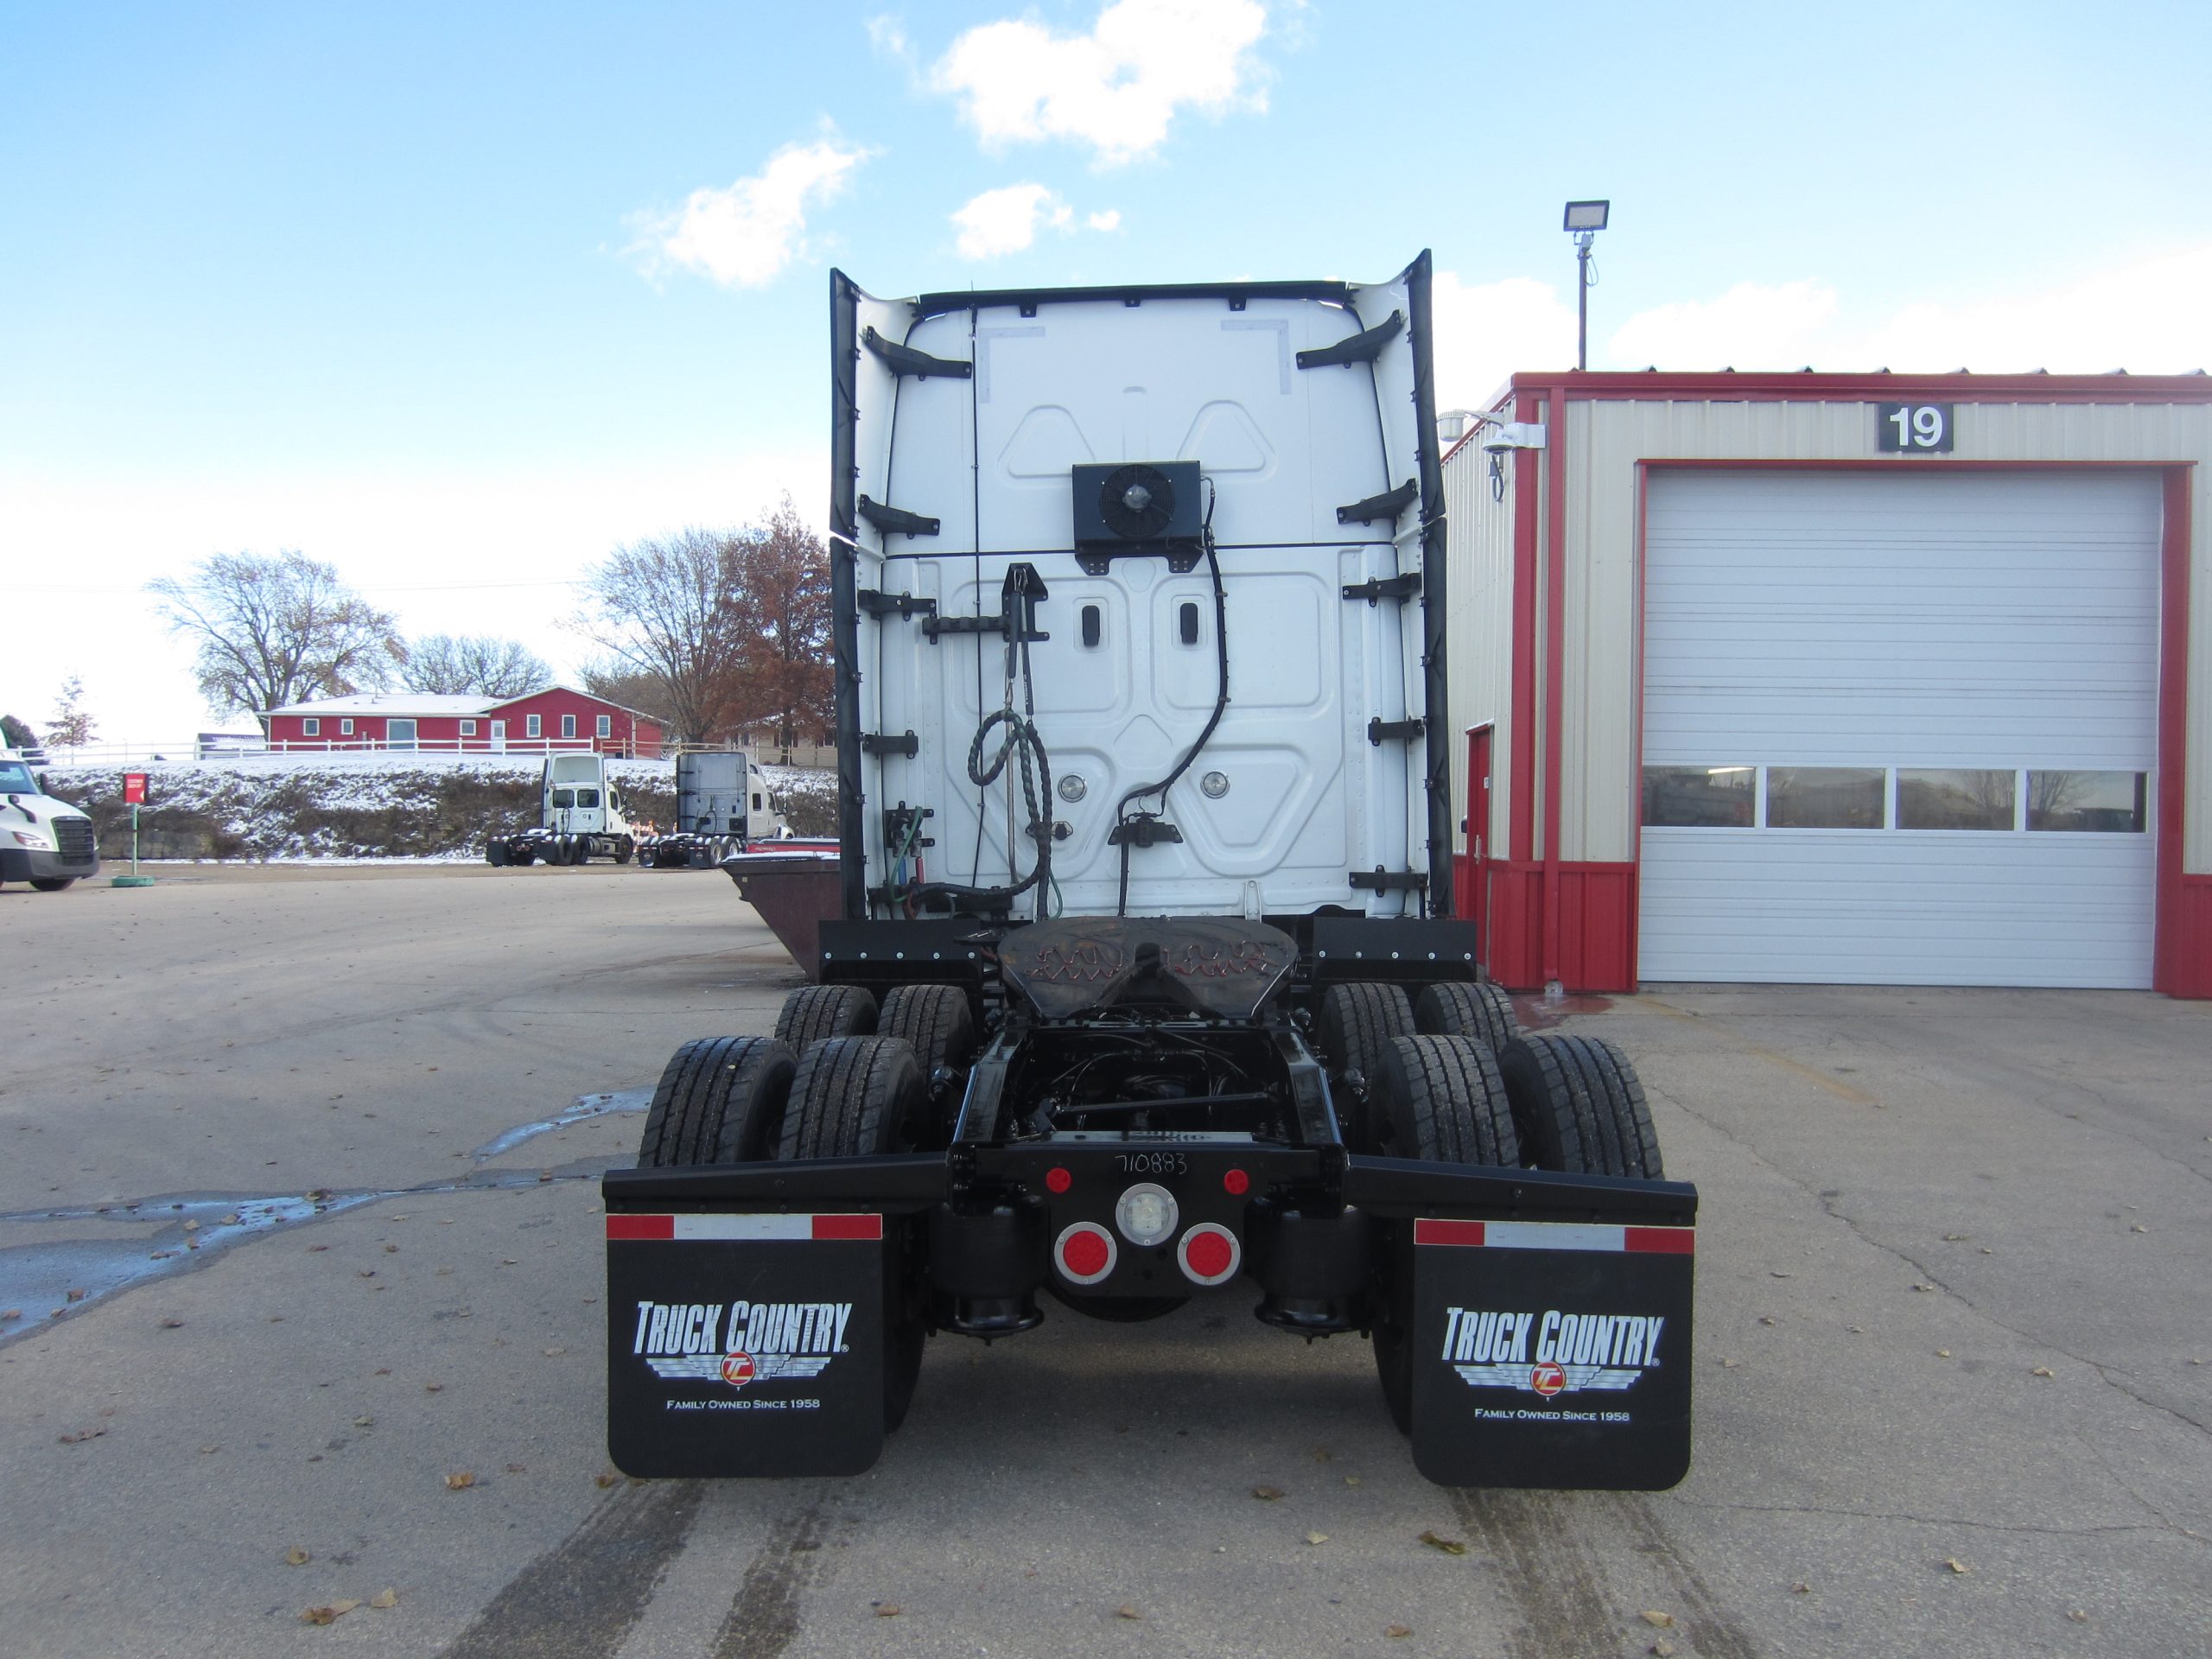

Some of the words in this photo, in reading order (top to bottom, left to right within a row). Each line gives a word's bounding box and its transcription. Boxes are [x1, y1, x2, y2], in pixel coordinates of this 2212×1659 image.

[1890, 406, 1942, 447] 19
[1115, 1152, 1187, 1174] 710883
[633, 1300, 723, 1355] TRUCK
[725, 1300, 853, 1355] COUNTRY
[1441, 1306, 1534, 1363] TRUCK
[1535, 1309, 1665, 1366] COUNTRY
[666, 1400, 706, 1409] FAMILY
[708, 1400, 751, 1409] OWNED
[753, 1400, 787, 1408] SINCE
[790, 1399, 821, 1408] 1958
[1474, 1408, 1516, 1419] FAMILY
[1516, 1409, 1560, 1420] OWNED
[1562, 1410, 1597, 1421] SINCE
[1599, 1412, 1630, 1421] 1958
